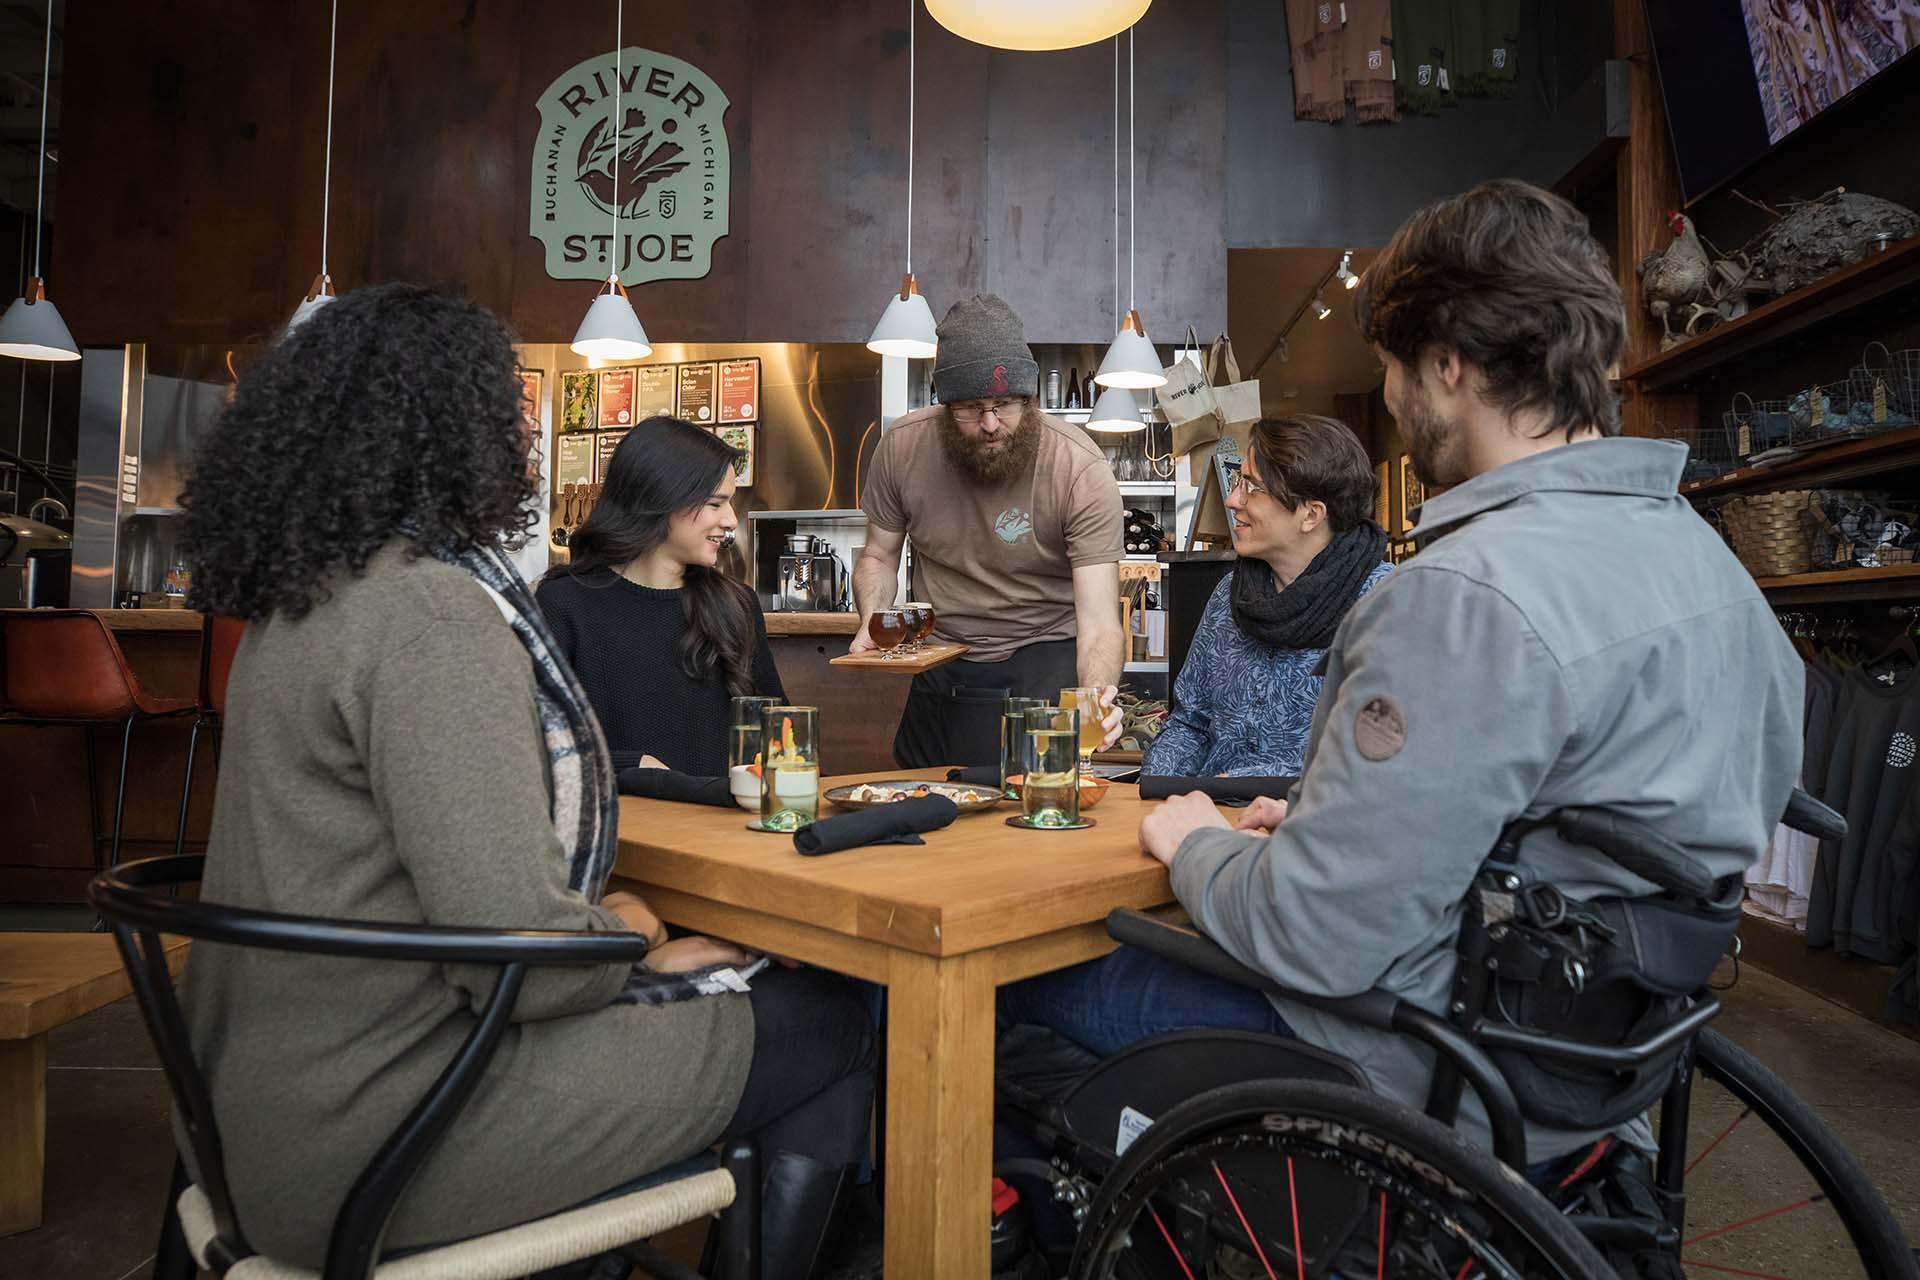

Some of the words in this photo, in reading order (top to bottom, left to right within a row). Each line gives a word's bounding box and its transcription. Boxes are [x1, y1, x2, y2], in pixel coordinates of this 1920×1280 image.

[558, 65, 706, 119] RIVER
[545, 124, 567, 222] BUCHANAN
[697, 123, 714, 221] MICHIGAN
[620, 234, 694, 272] JOE
